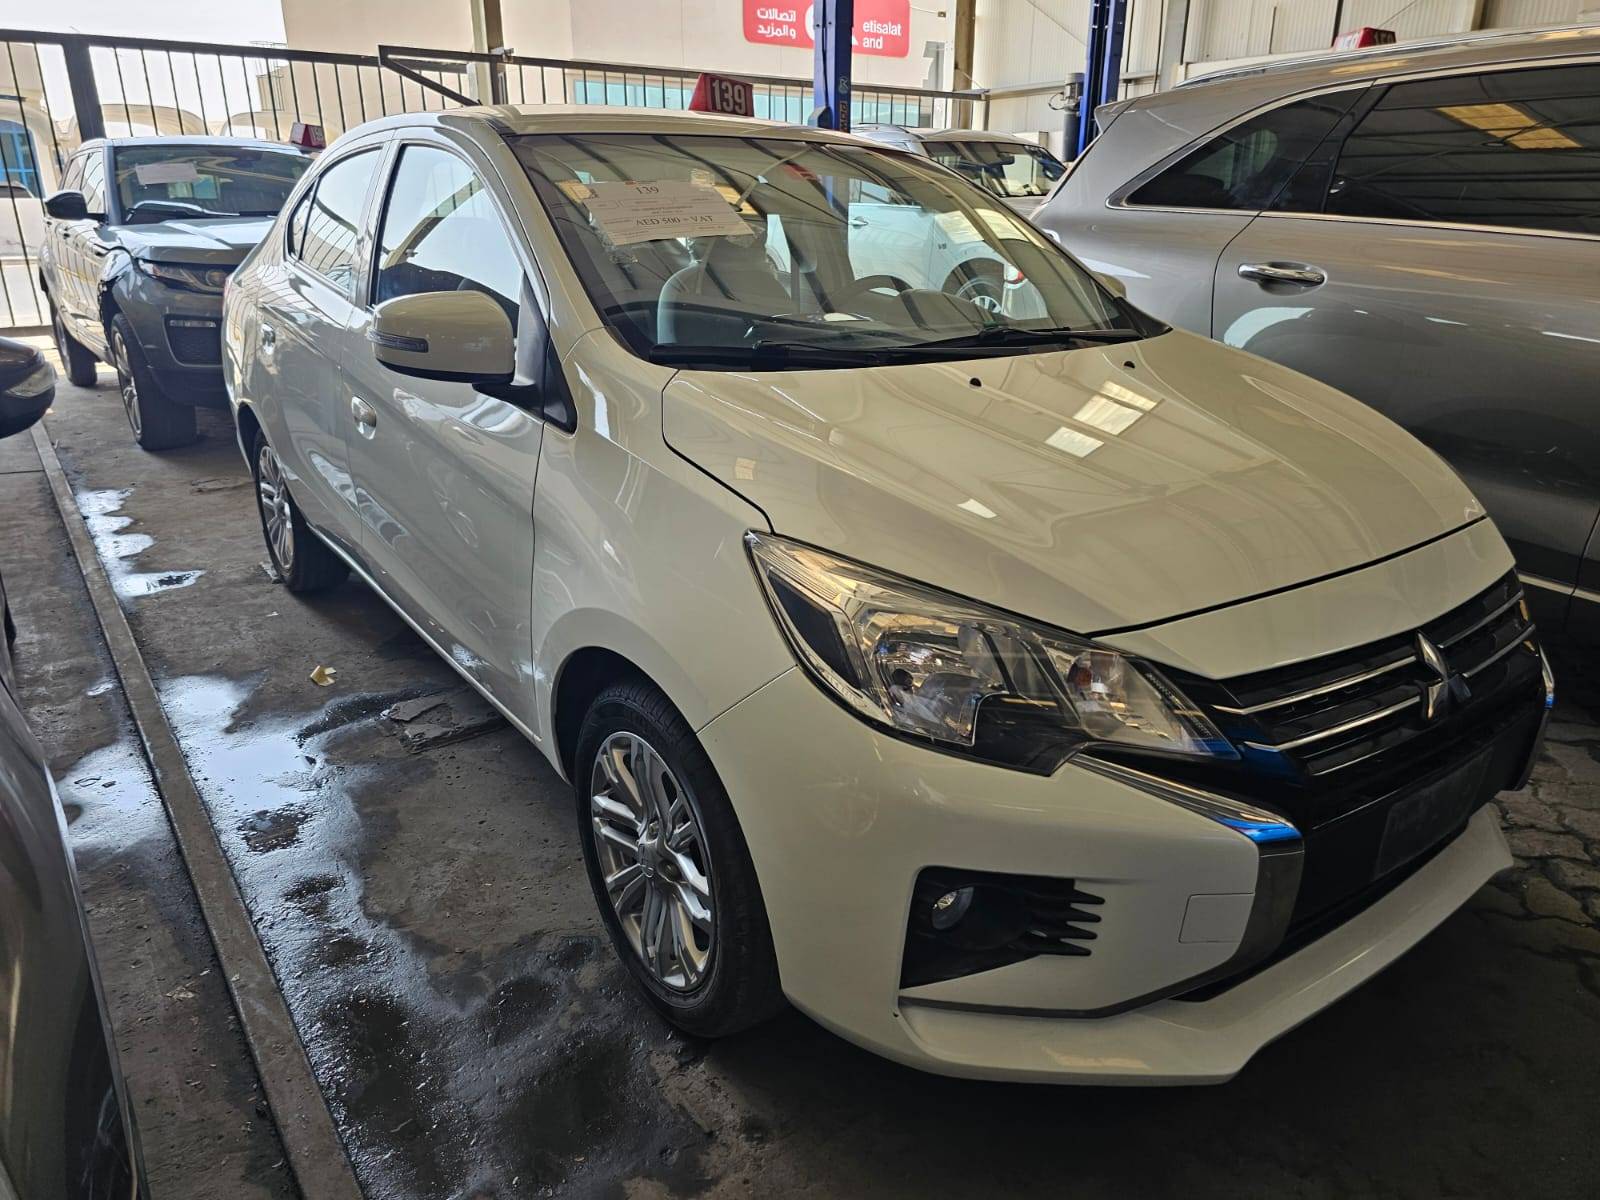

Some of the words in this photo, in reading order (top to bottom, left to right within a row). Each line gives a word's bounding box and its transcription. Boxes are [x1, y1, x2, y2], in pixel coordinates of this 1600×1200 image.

[756, 8, 796, 22] اتصالات
[757, 24, 796, 40] والمزيد
[862, 20, 902, 37] etisalat
[862, 36, 883, 49] and
[712, 79, 746, 114] 139
[635, 186, 659, 194] 139
[636, 218, 660, 226] AED
